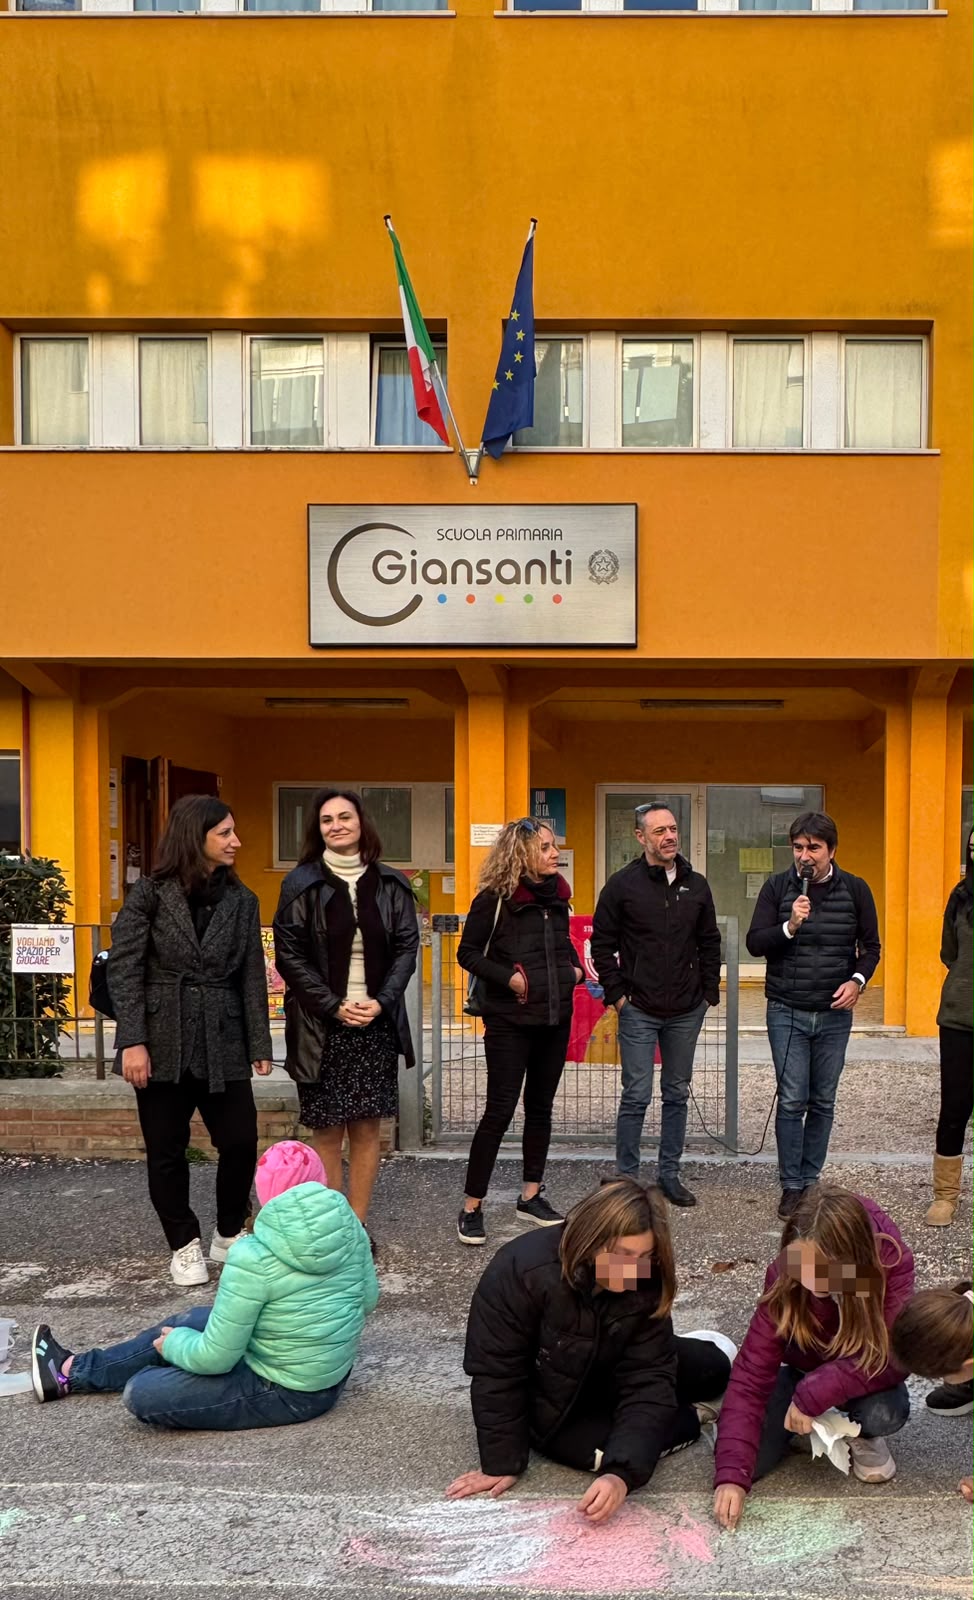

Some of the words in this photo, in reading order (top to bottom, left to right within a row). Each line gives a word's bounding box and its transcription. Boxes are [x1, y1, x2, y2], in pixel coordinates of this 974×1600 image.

[436, 528, 491, 541] SCUOLA
[496, 528, 563, 541] PRIMARIA
[372, 549, 573, 585] Giansanti
[16, 937, 55, 946] VOGLIAMO
[16, 946, 44, 956] SPAZIO
[45, 946, 61, 956] PER
[16, 956, 50, 965] GIOCARE
